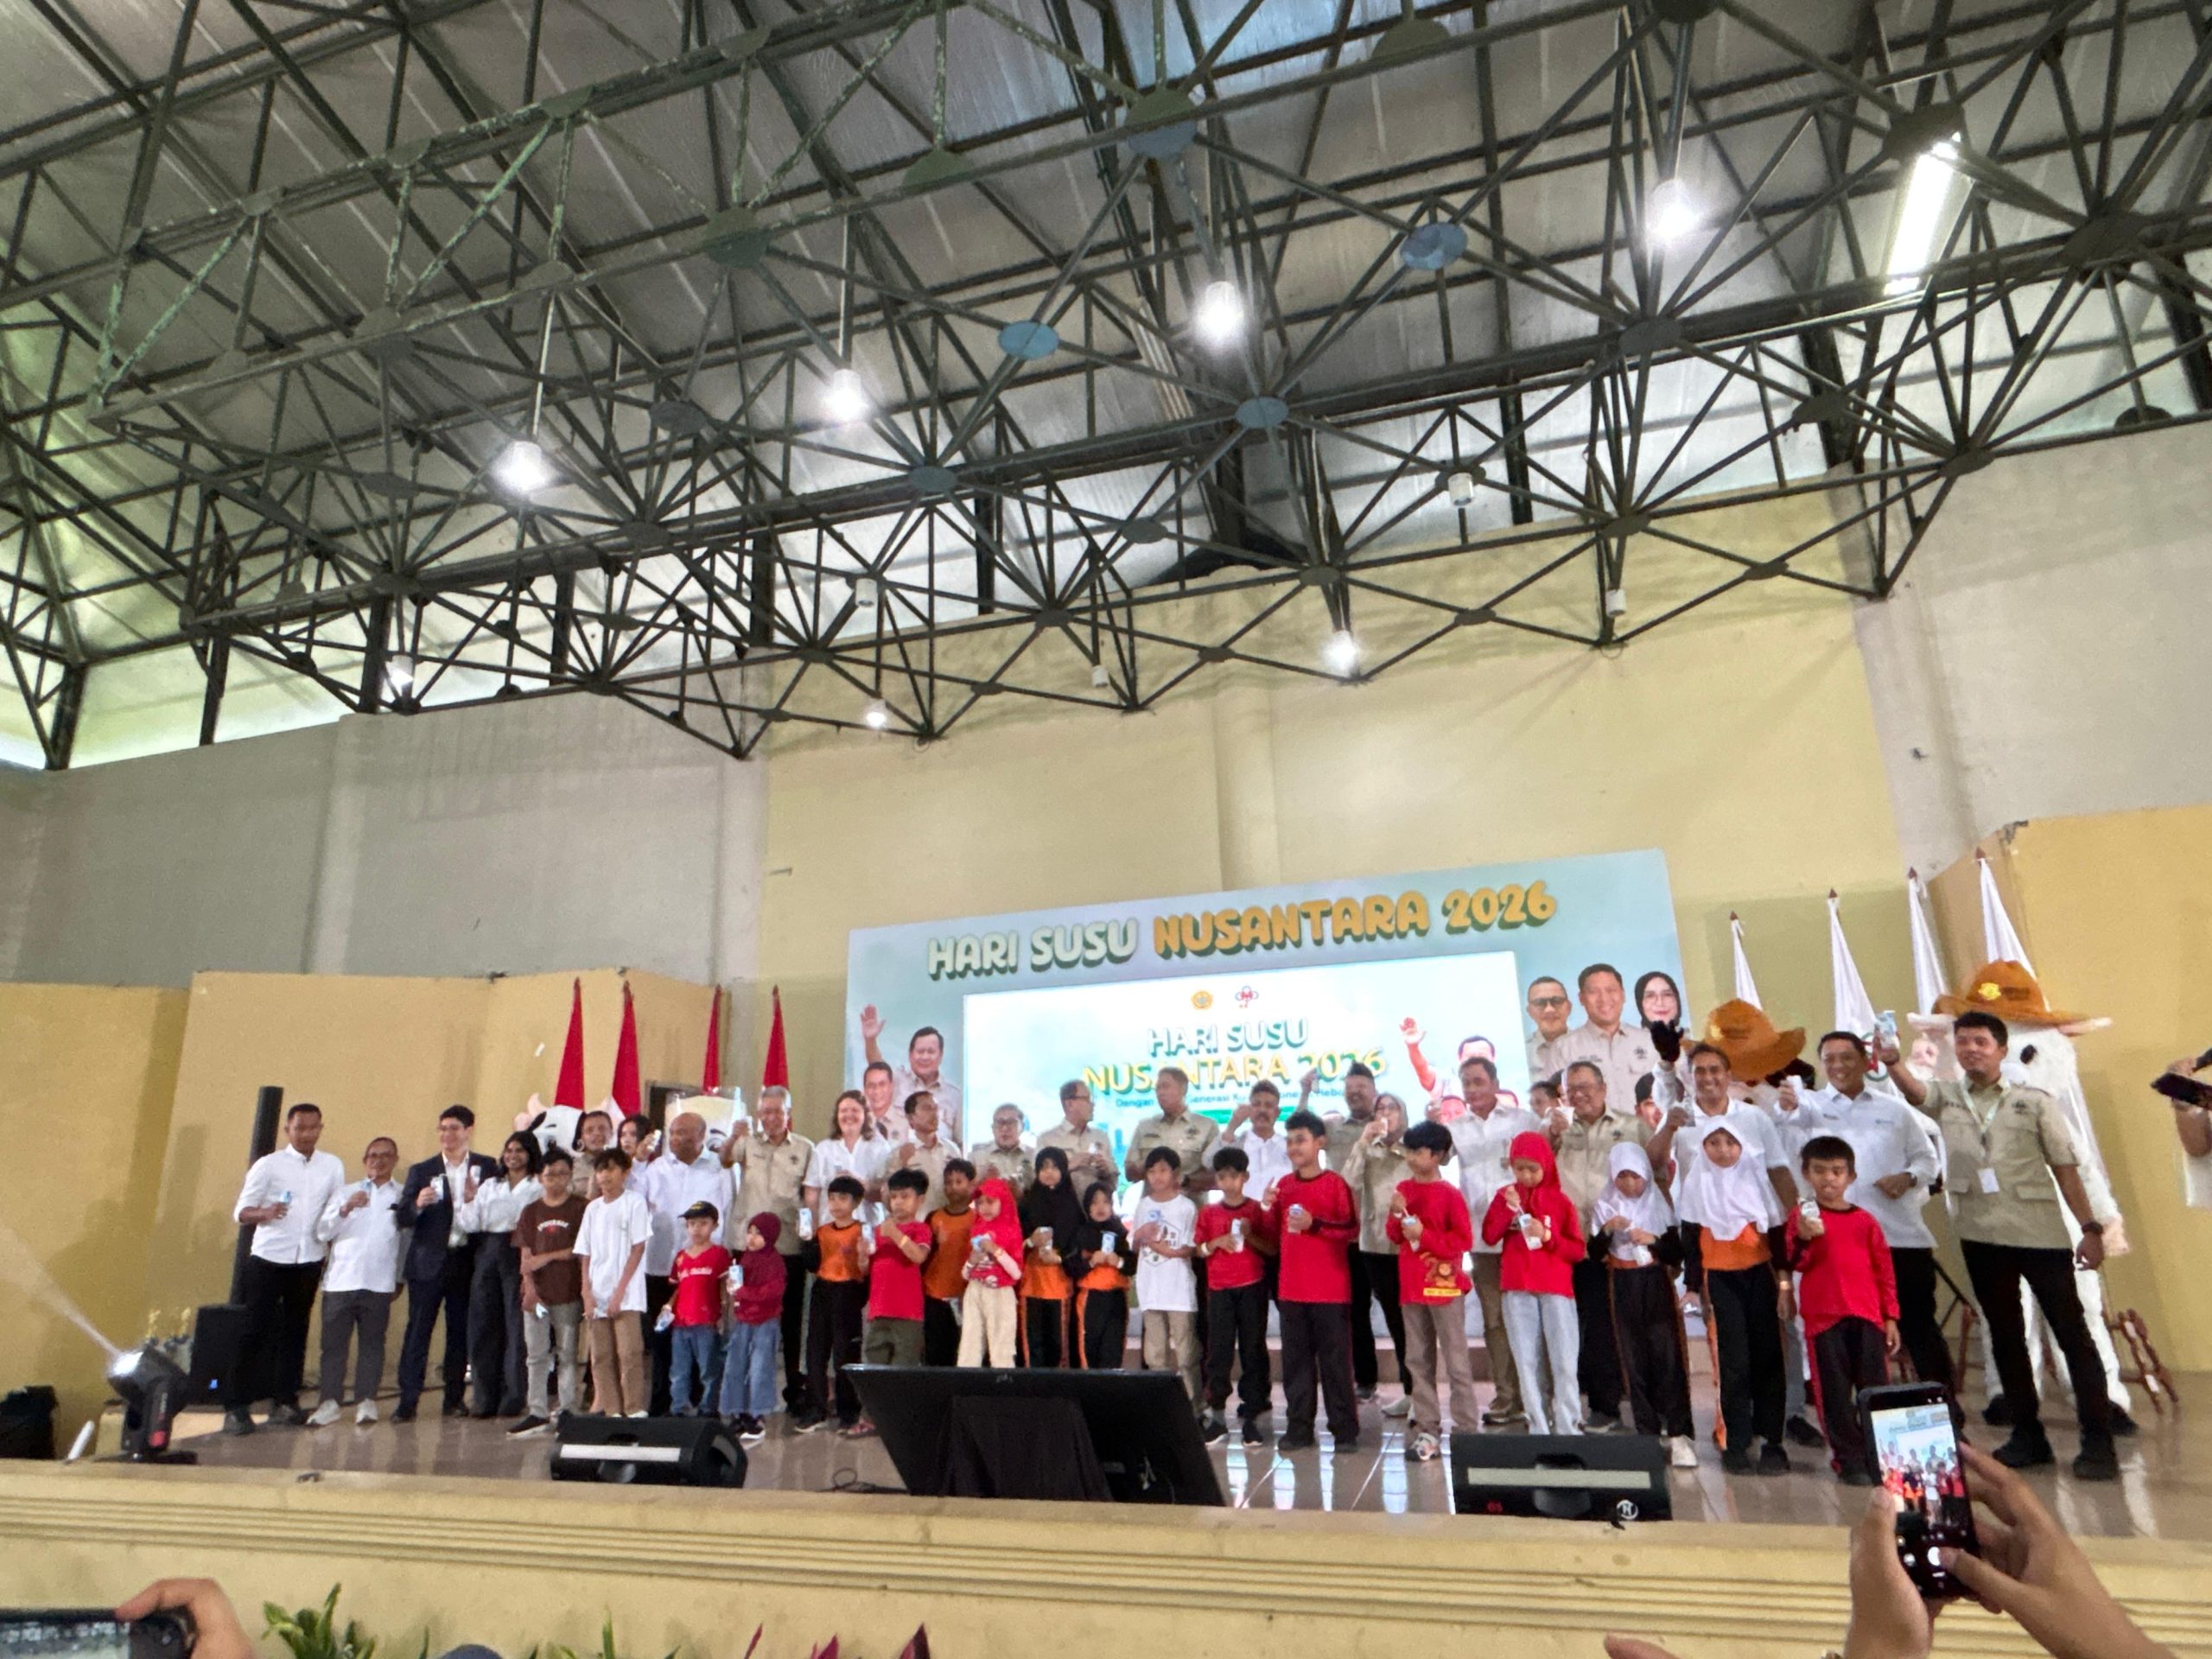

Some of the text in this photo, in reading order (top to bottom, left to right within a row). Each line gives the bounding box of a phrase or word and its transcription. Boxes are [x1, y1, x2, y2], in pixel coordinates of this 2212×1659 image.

[927, 880, 1559, 982] HARI SUSU NUSANTARA 2026
[1147, 1018, 1309, 1058] HARI SUSU
[1082, 1052, 1291, 1096] NUSNTARA
